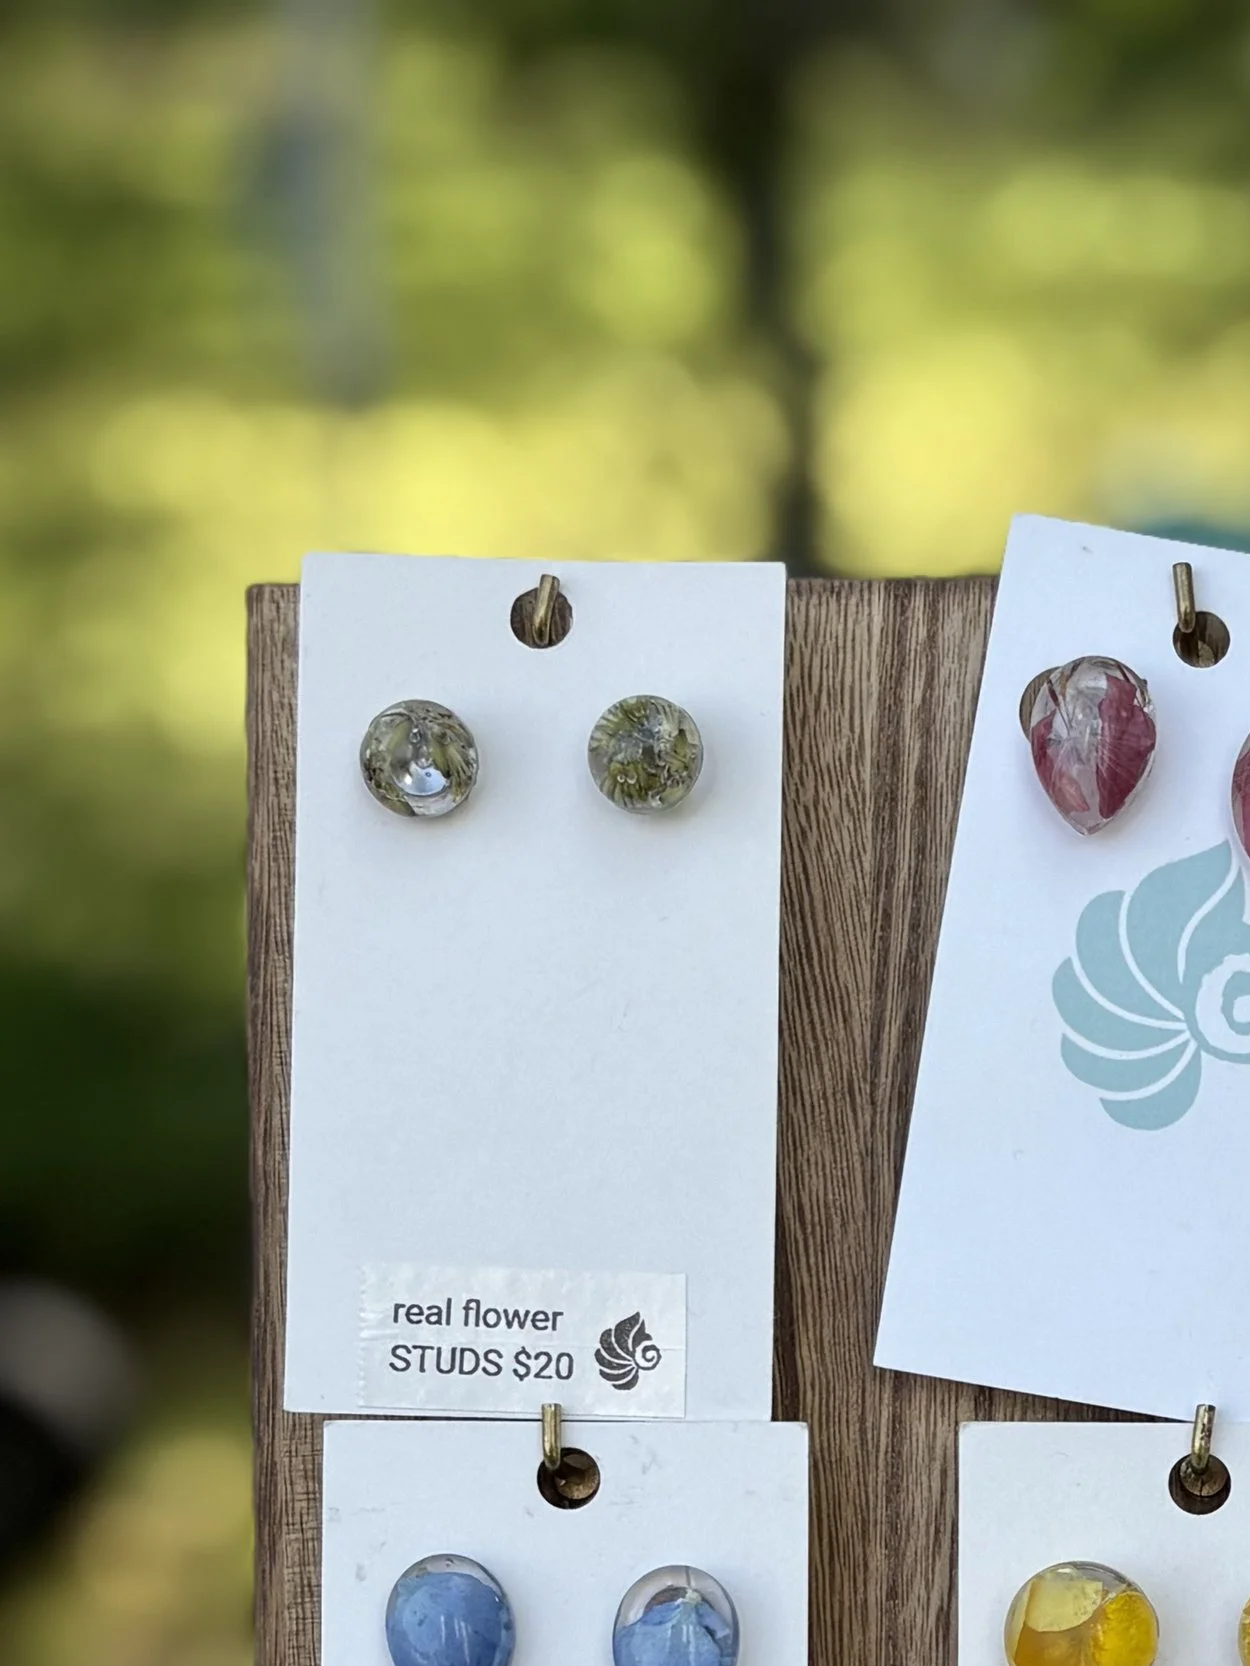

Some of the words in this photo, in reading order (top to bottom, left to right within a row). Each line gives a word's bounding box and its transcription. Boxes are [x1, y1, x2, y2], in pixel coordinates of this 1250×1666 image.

[393, 1298, 452, 1327] real
[463, 1298, 564, 1331] flower
[389, 1345, 503, 1377] STUDS
[512, 1346, 574, 1381] $20
